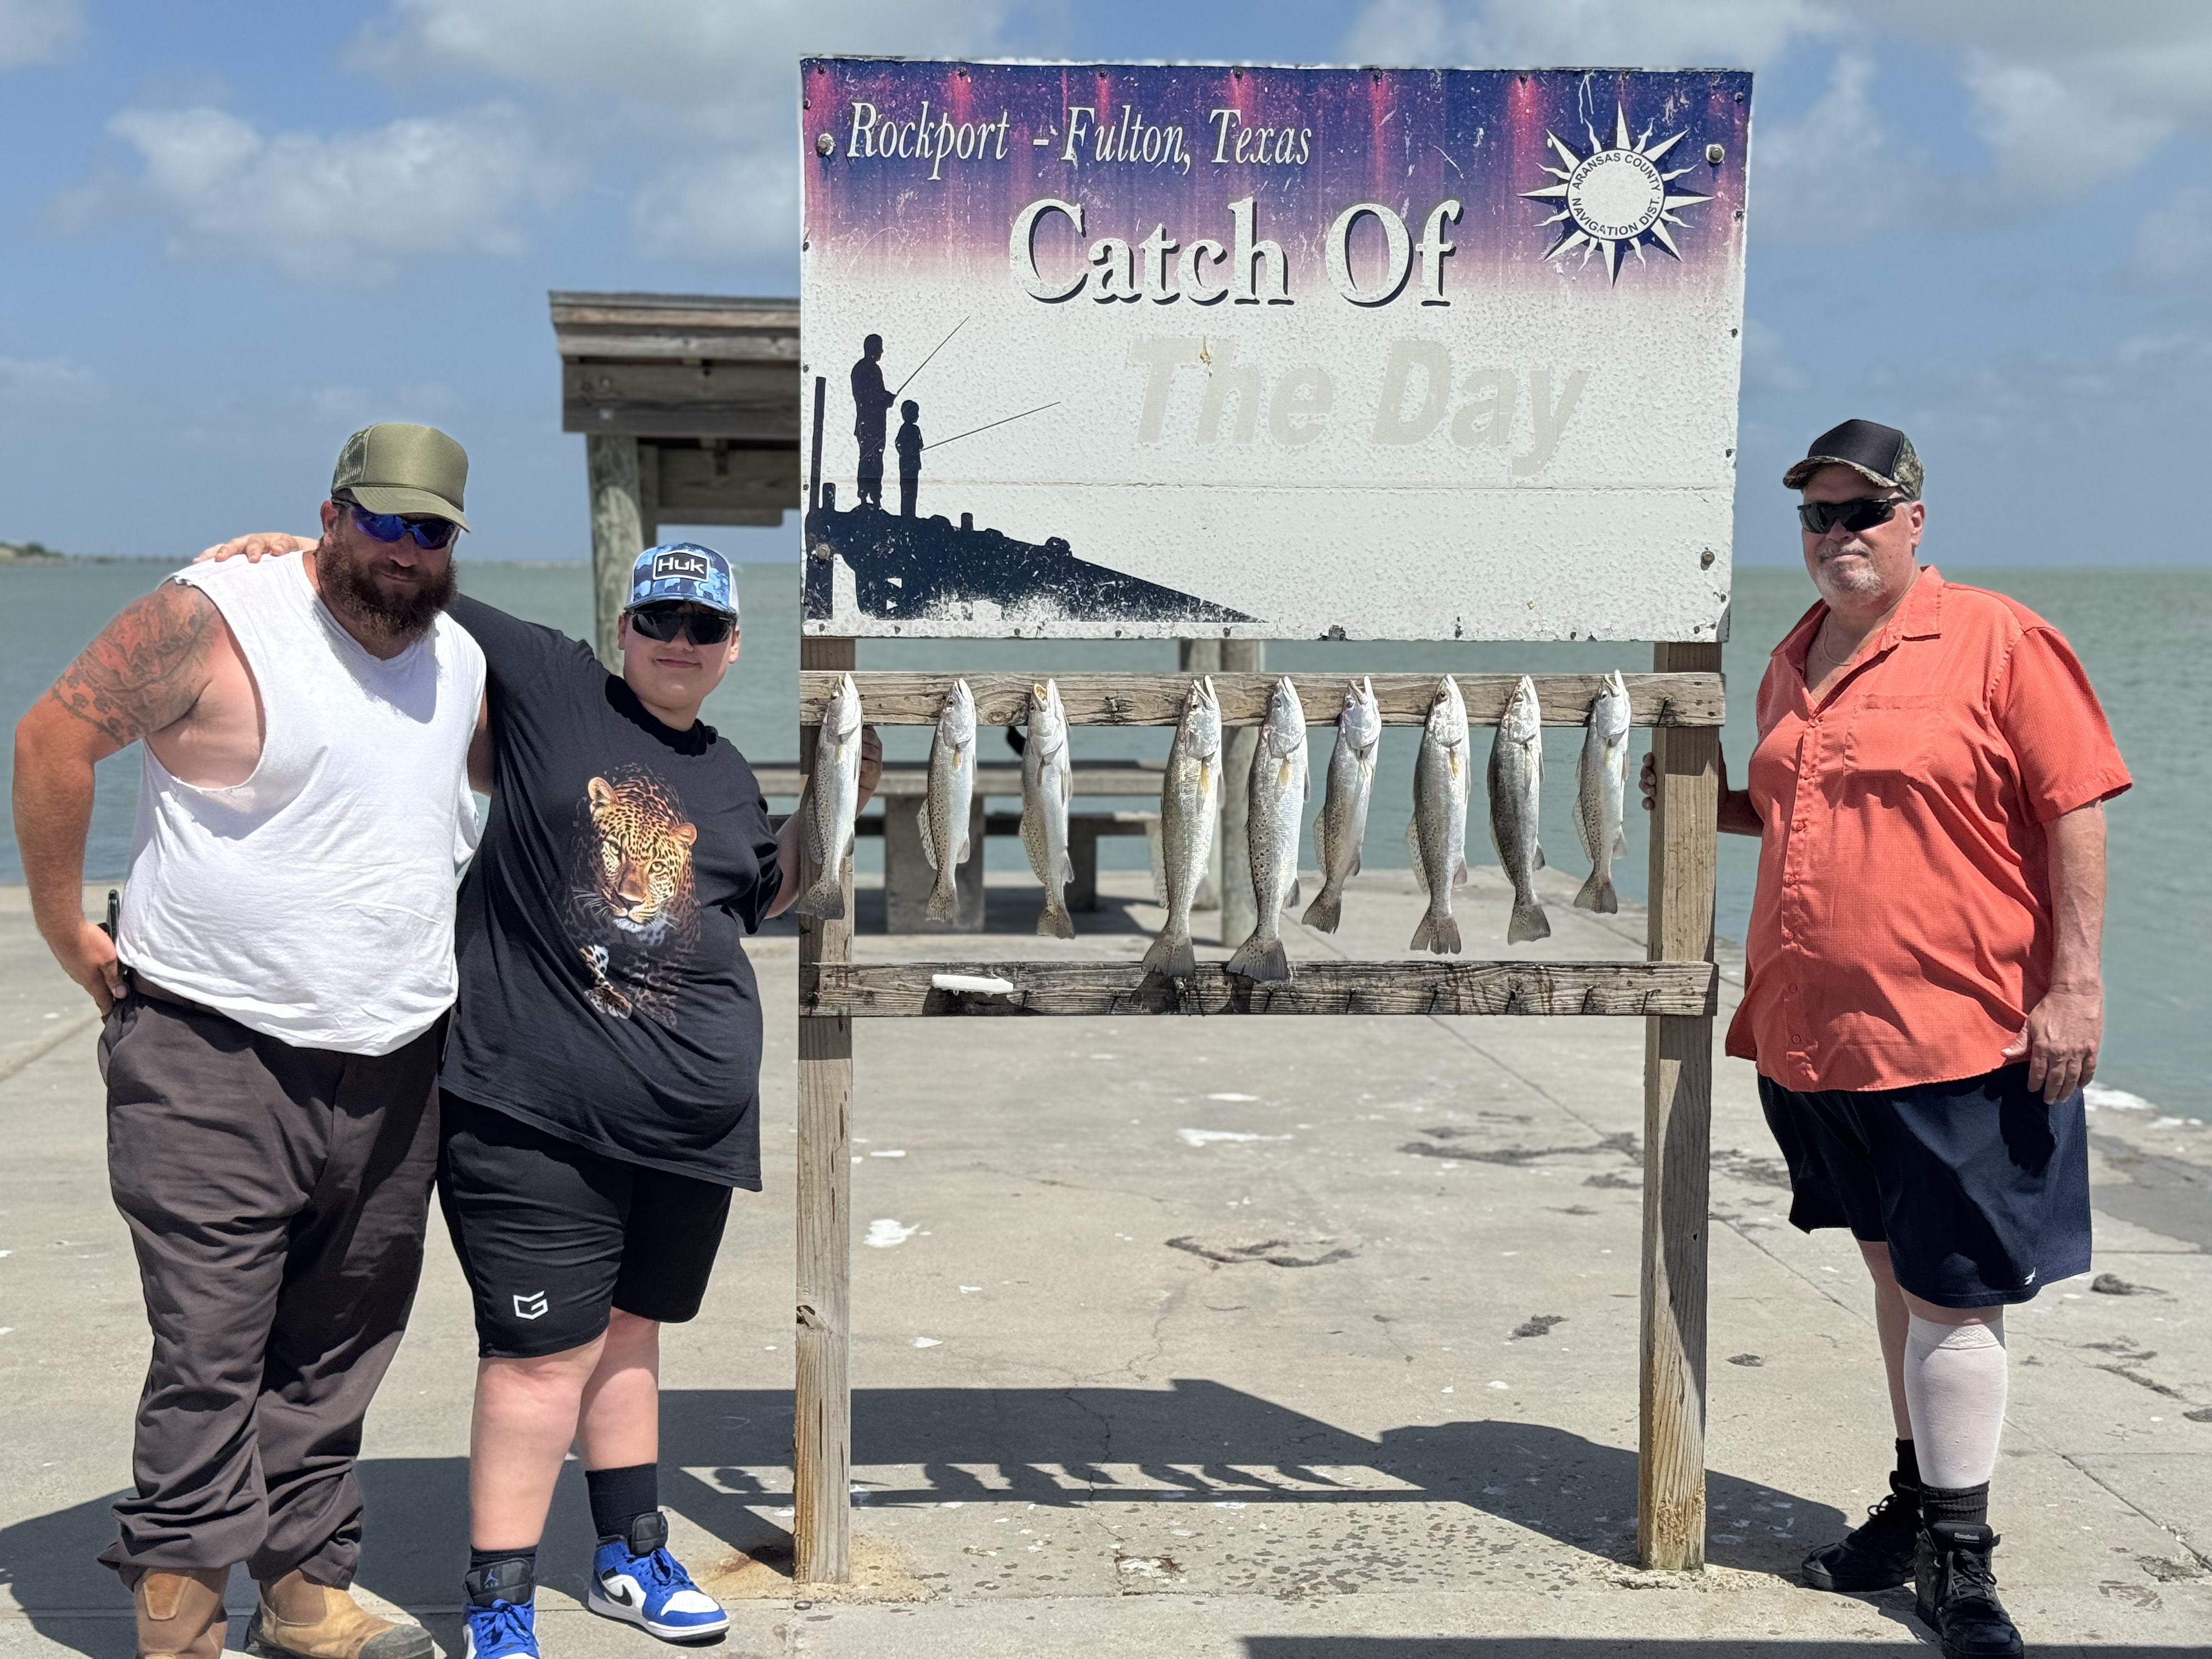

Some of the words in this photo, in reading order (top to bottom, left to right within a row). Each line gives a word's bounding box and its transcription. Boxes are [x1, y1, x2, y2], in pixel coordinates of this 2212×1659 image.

[847, 101, 1010, 180] Rockport
[1209, 109, 1312, 165] Texas
[1572, 153, 1621, 190] ARANSAS
[1625, 154, 1661, 191] COUNTY
[1572, 198, 1638, 235] NAVIGATION
[1639, 196, 1660, 225] DIST.
[1009, 196, 1294, 306] Catch
[1325, 199, 1464, 308] Of
[1128, 335, 1335, 447] The
[1372, 340, 1592, 478] Day
[1954, 1532, 1980, 1541] Reebok
